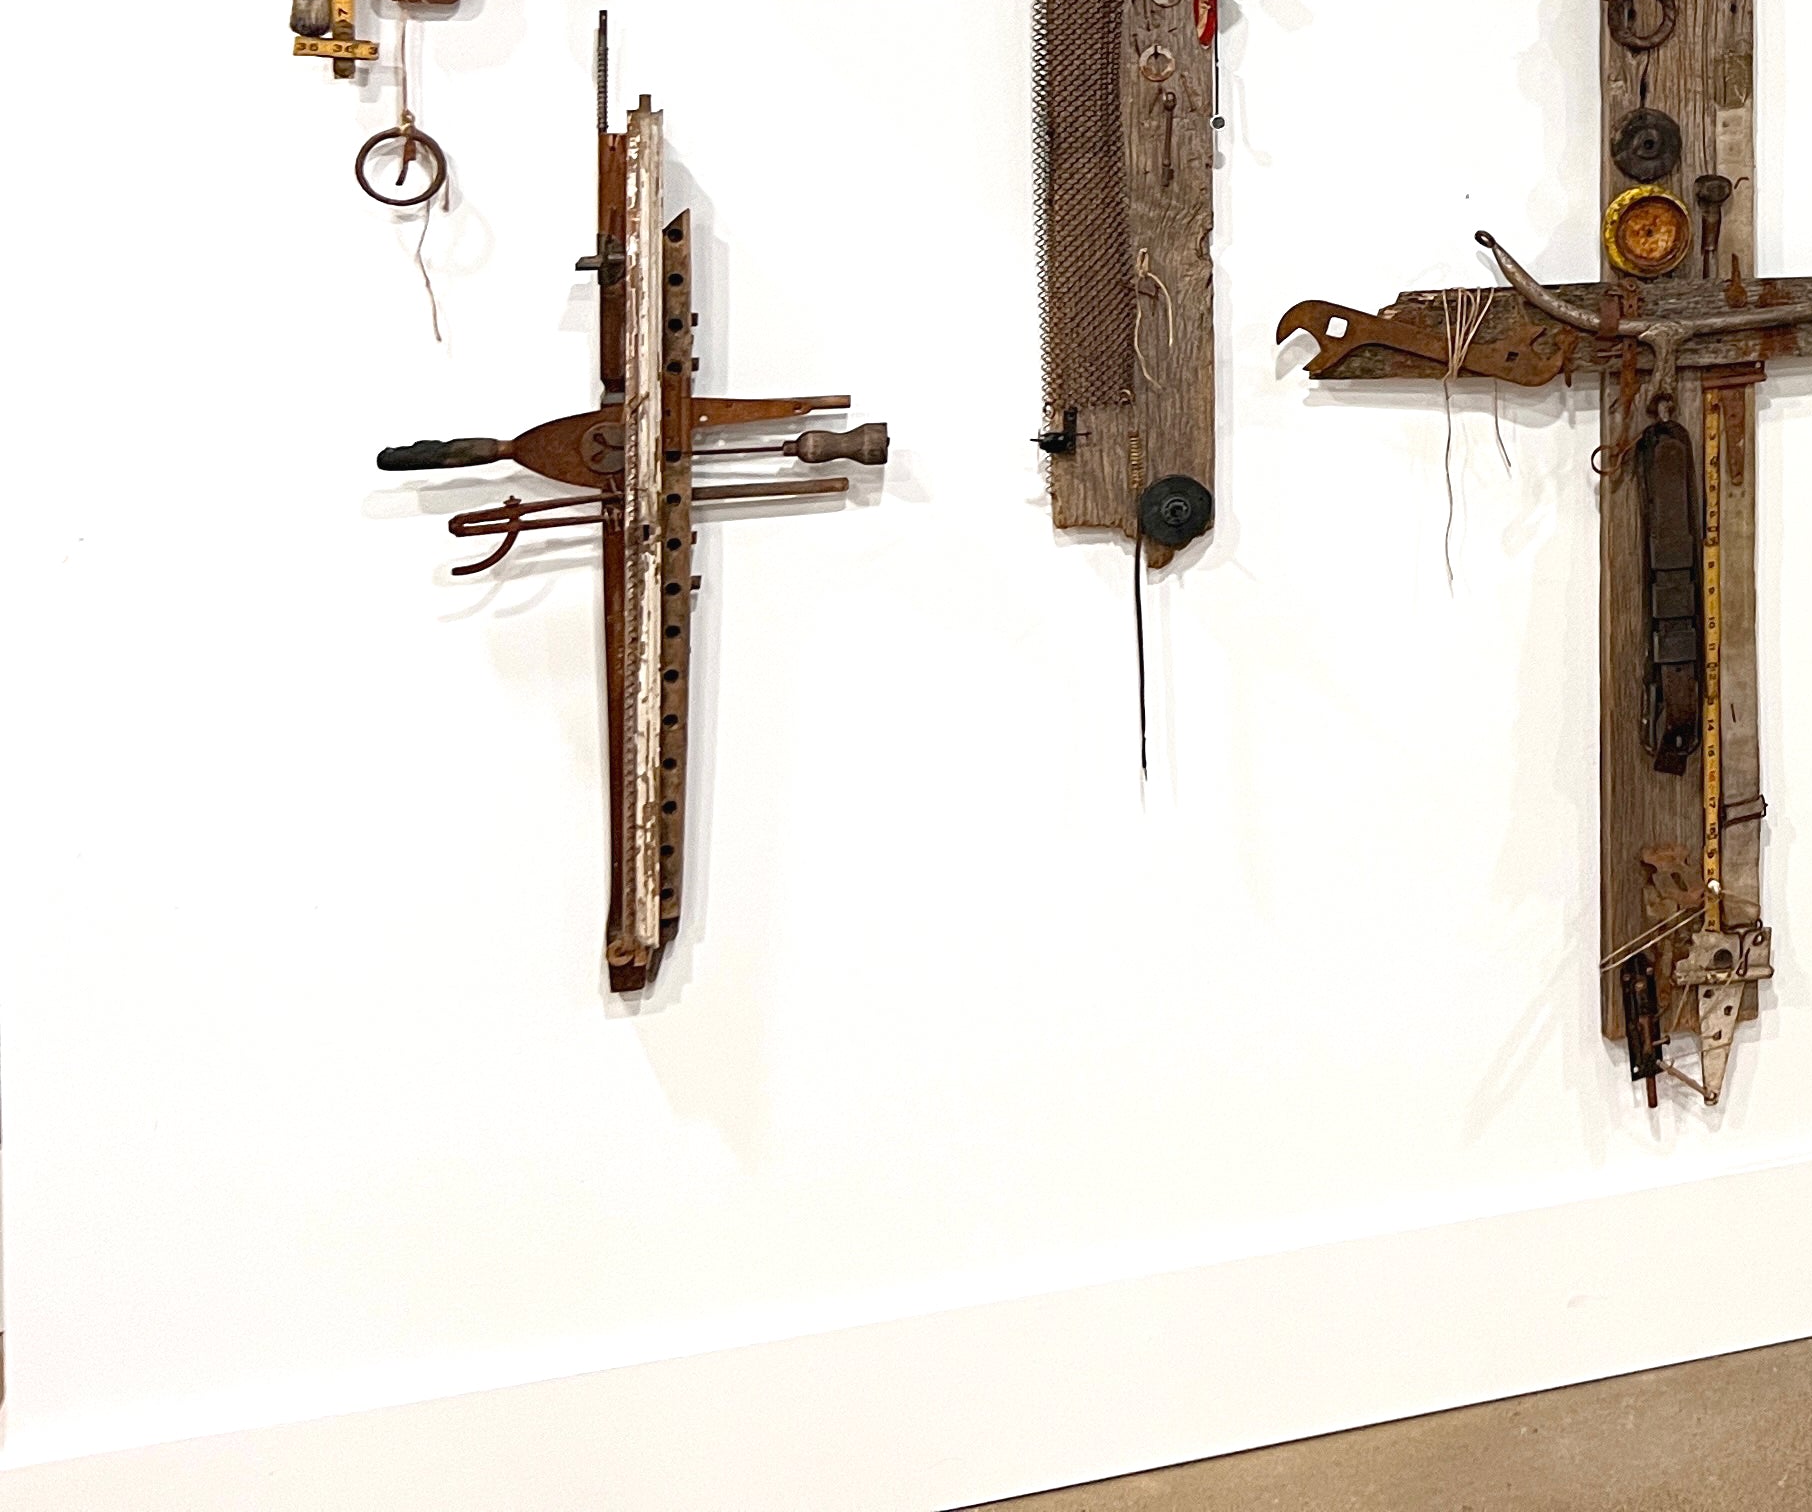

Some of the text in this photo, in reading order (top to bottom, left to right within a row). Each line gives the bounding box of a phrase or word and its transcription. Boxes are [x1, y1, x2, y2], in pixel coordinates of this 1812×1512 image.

[1708, 616, 1716, 629] 10
[1708, 642, 1716, 651] 11
[1707, 719, 1715, 731] 14
[1708, 796, 1716, 809] 17
